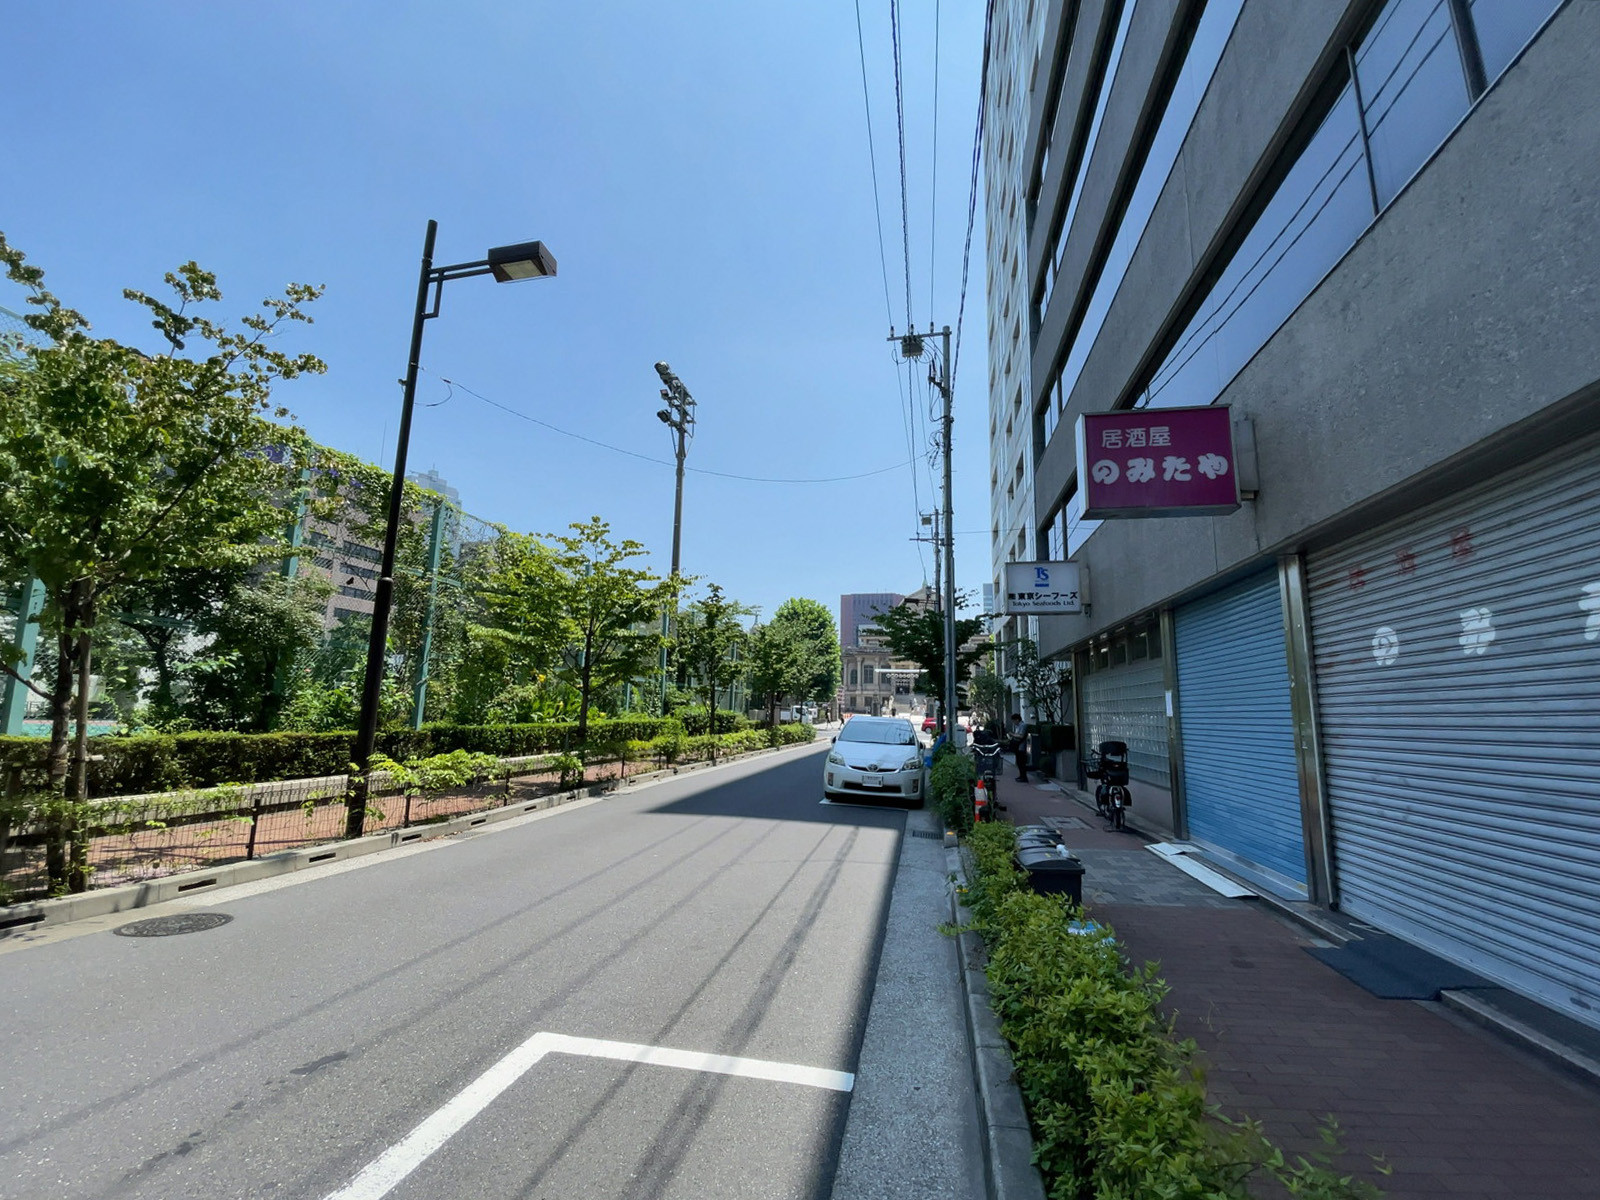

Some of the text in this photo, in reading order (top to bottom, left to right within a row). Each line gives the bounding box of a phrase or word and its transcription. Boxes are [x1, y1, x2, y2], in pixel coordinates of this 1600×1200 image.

[1101, 426, 1172, 449] 居酒屋
[1091, 453, 1229, 485] のみたや
[1012, 600, 1031, 608] Tokyo
